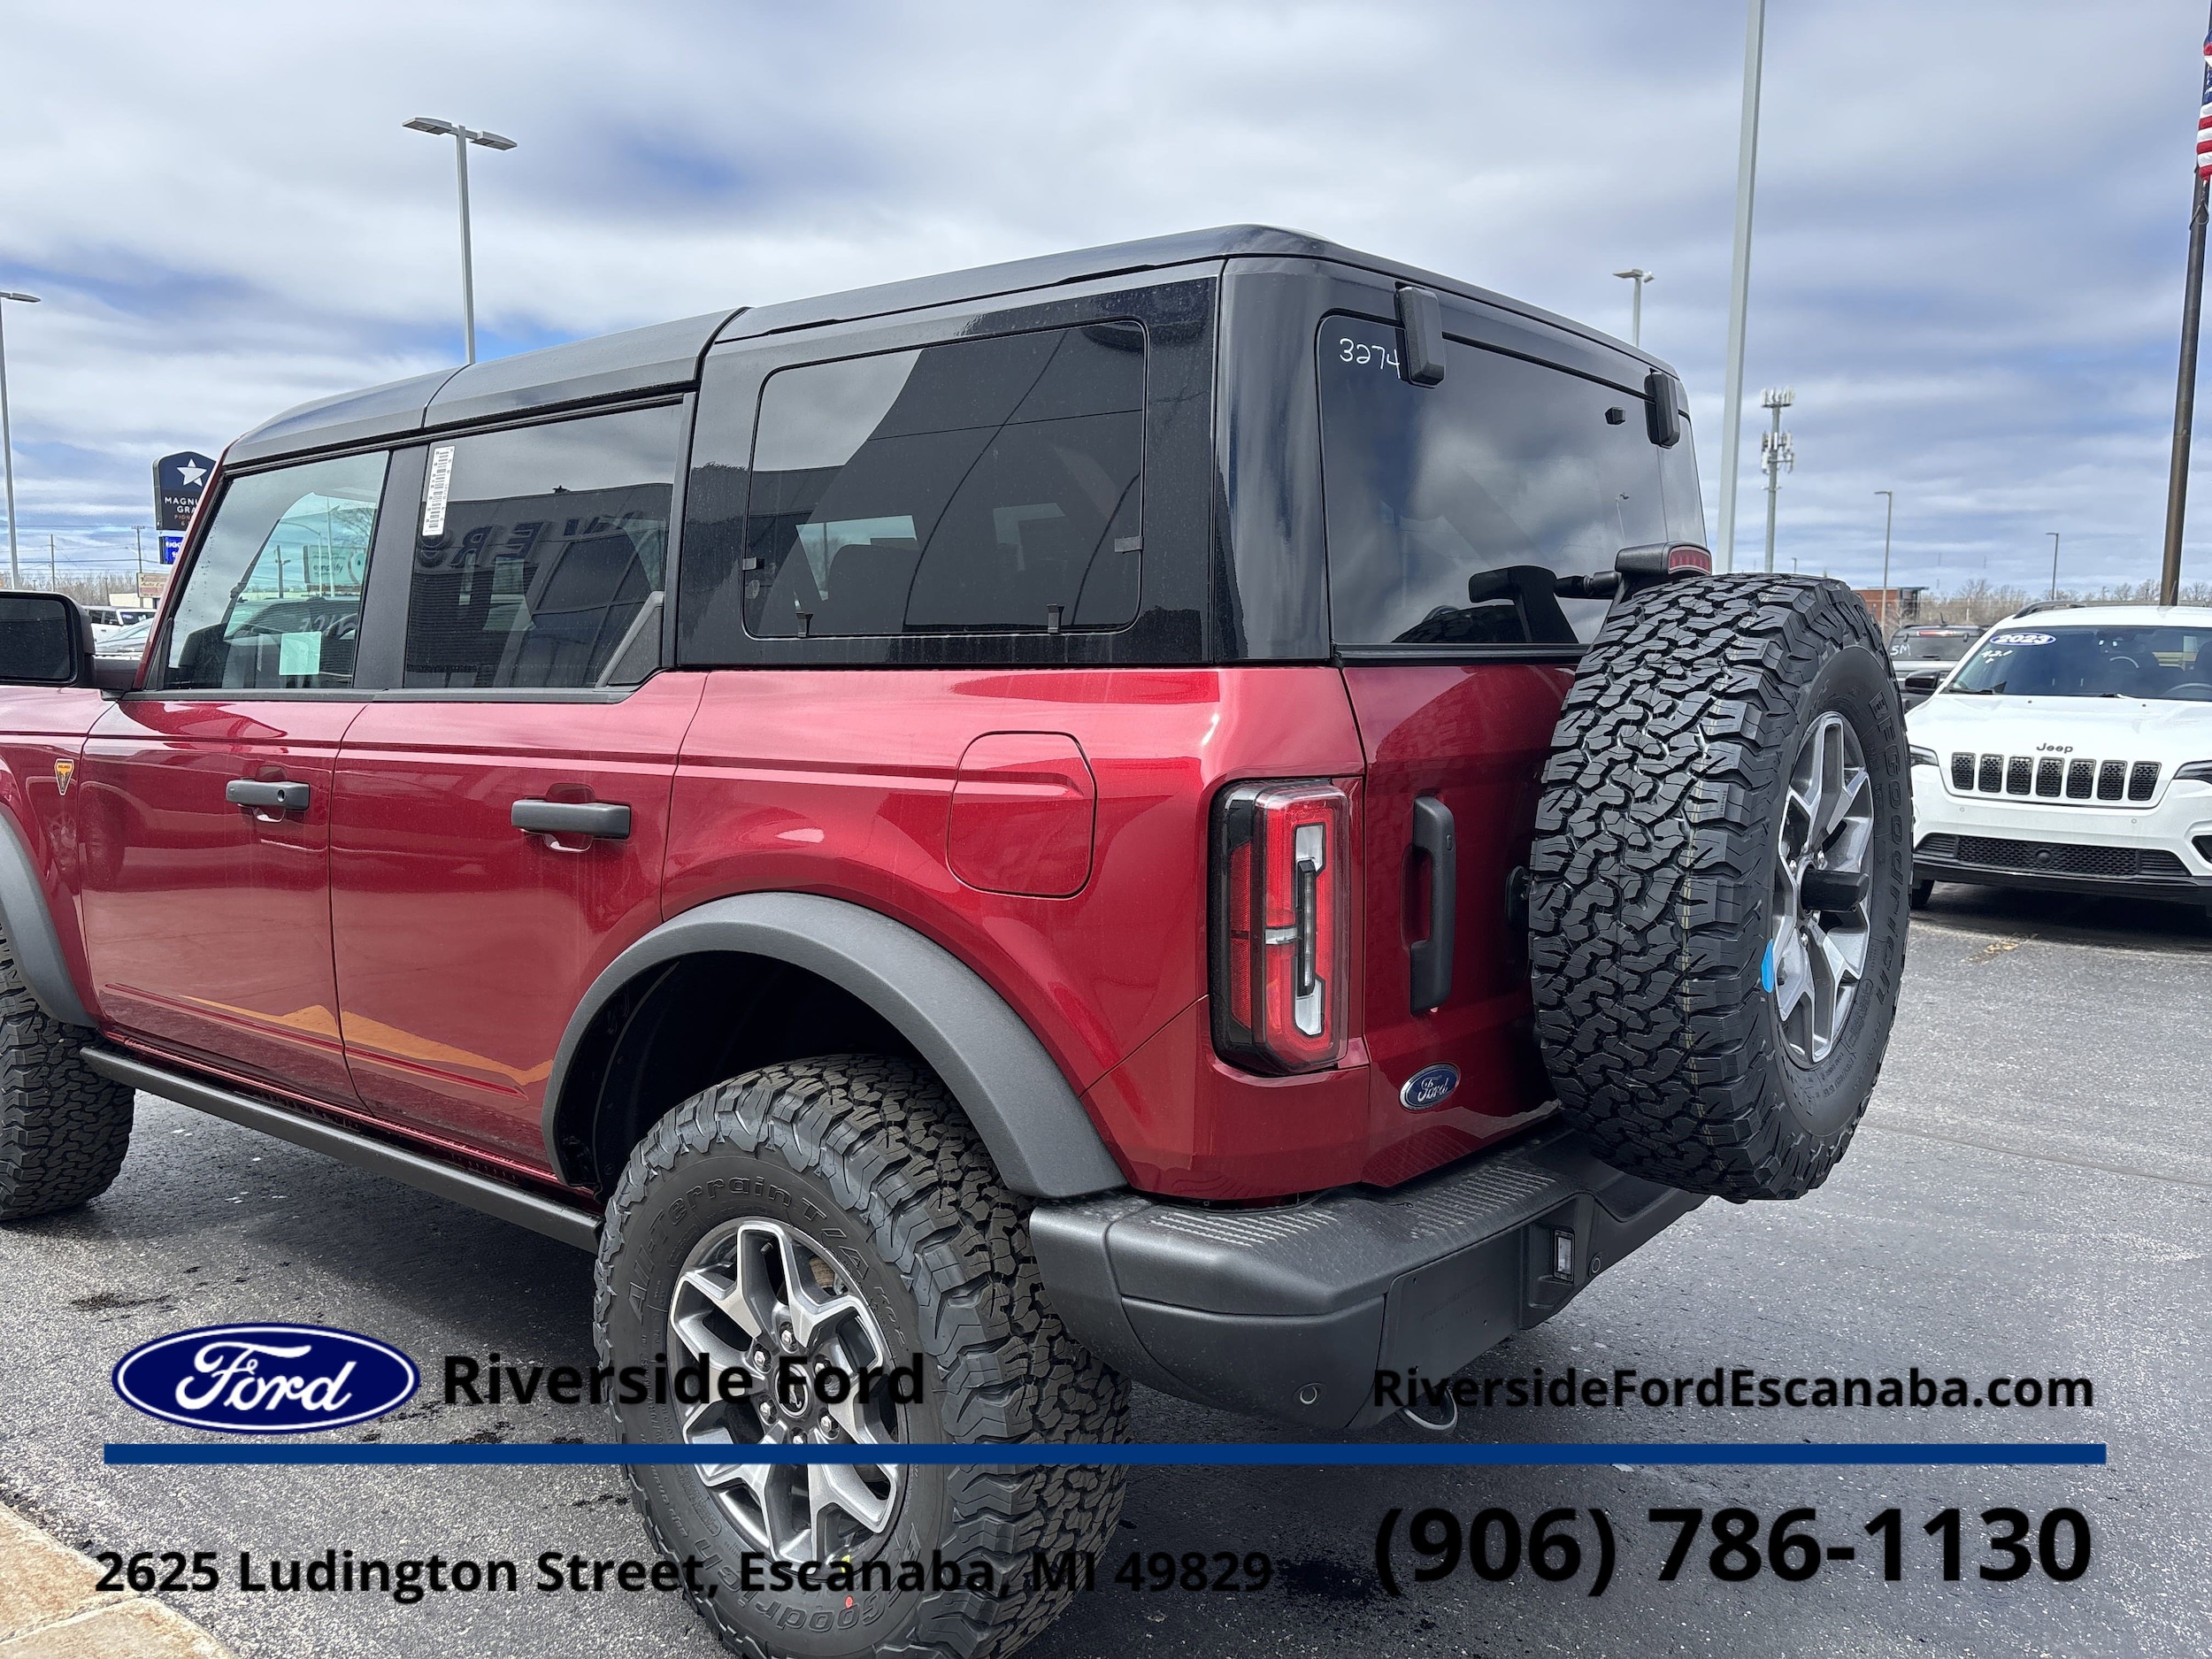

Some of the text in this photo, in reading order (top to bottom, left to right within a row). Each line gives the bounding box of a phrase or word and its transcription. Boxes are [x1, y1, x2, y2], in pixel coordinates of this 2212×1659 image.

[1339, 337, 1401, 380] 3274
[165, 496, 200, 505] MAGNU
[176, 505, 196, 514] GRA
[1994, 634, 2051, 645] 2023
[2036, 742, 2074, 754] Jeep
[1868, 690, 1904, 1005] BFGoodrich
[1417, 1074, 1449, 1103] Ford
